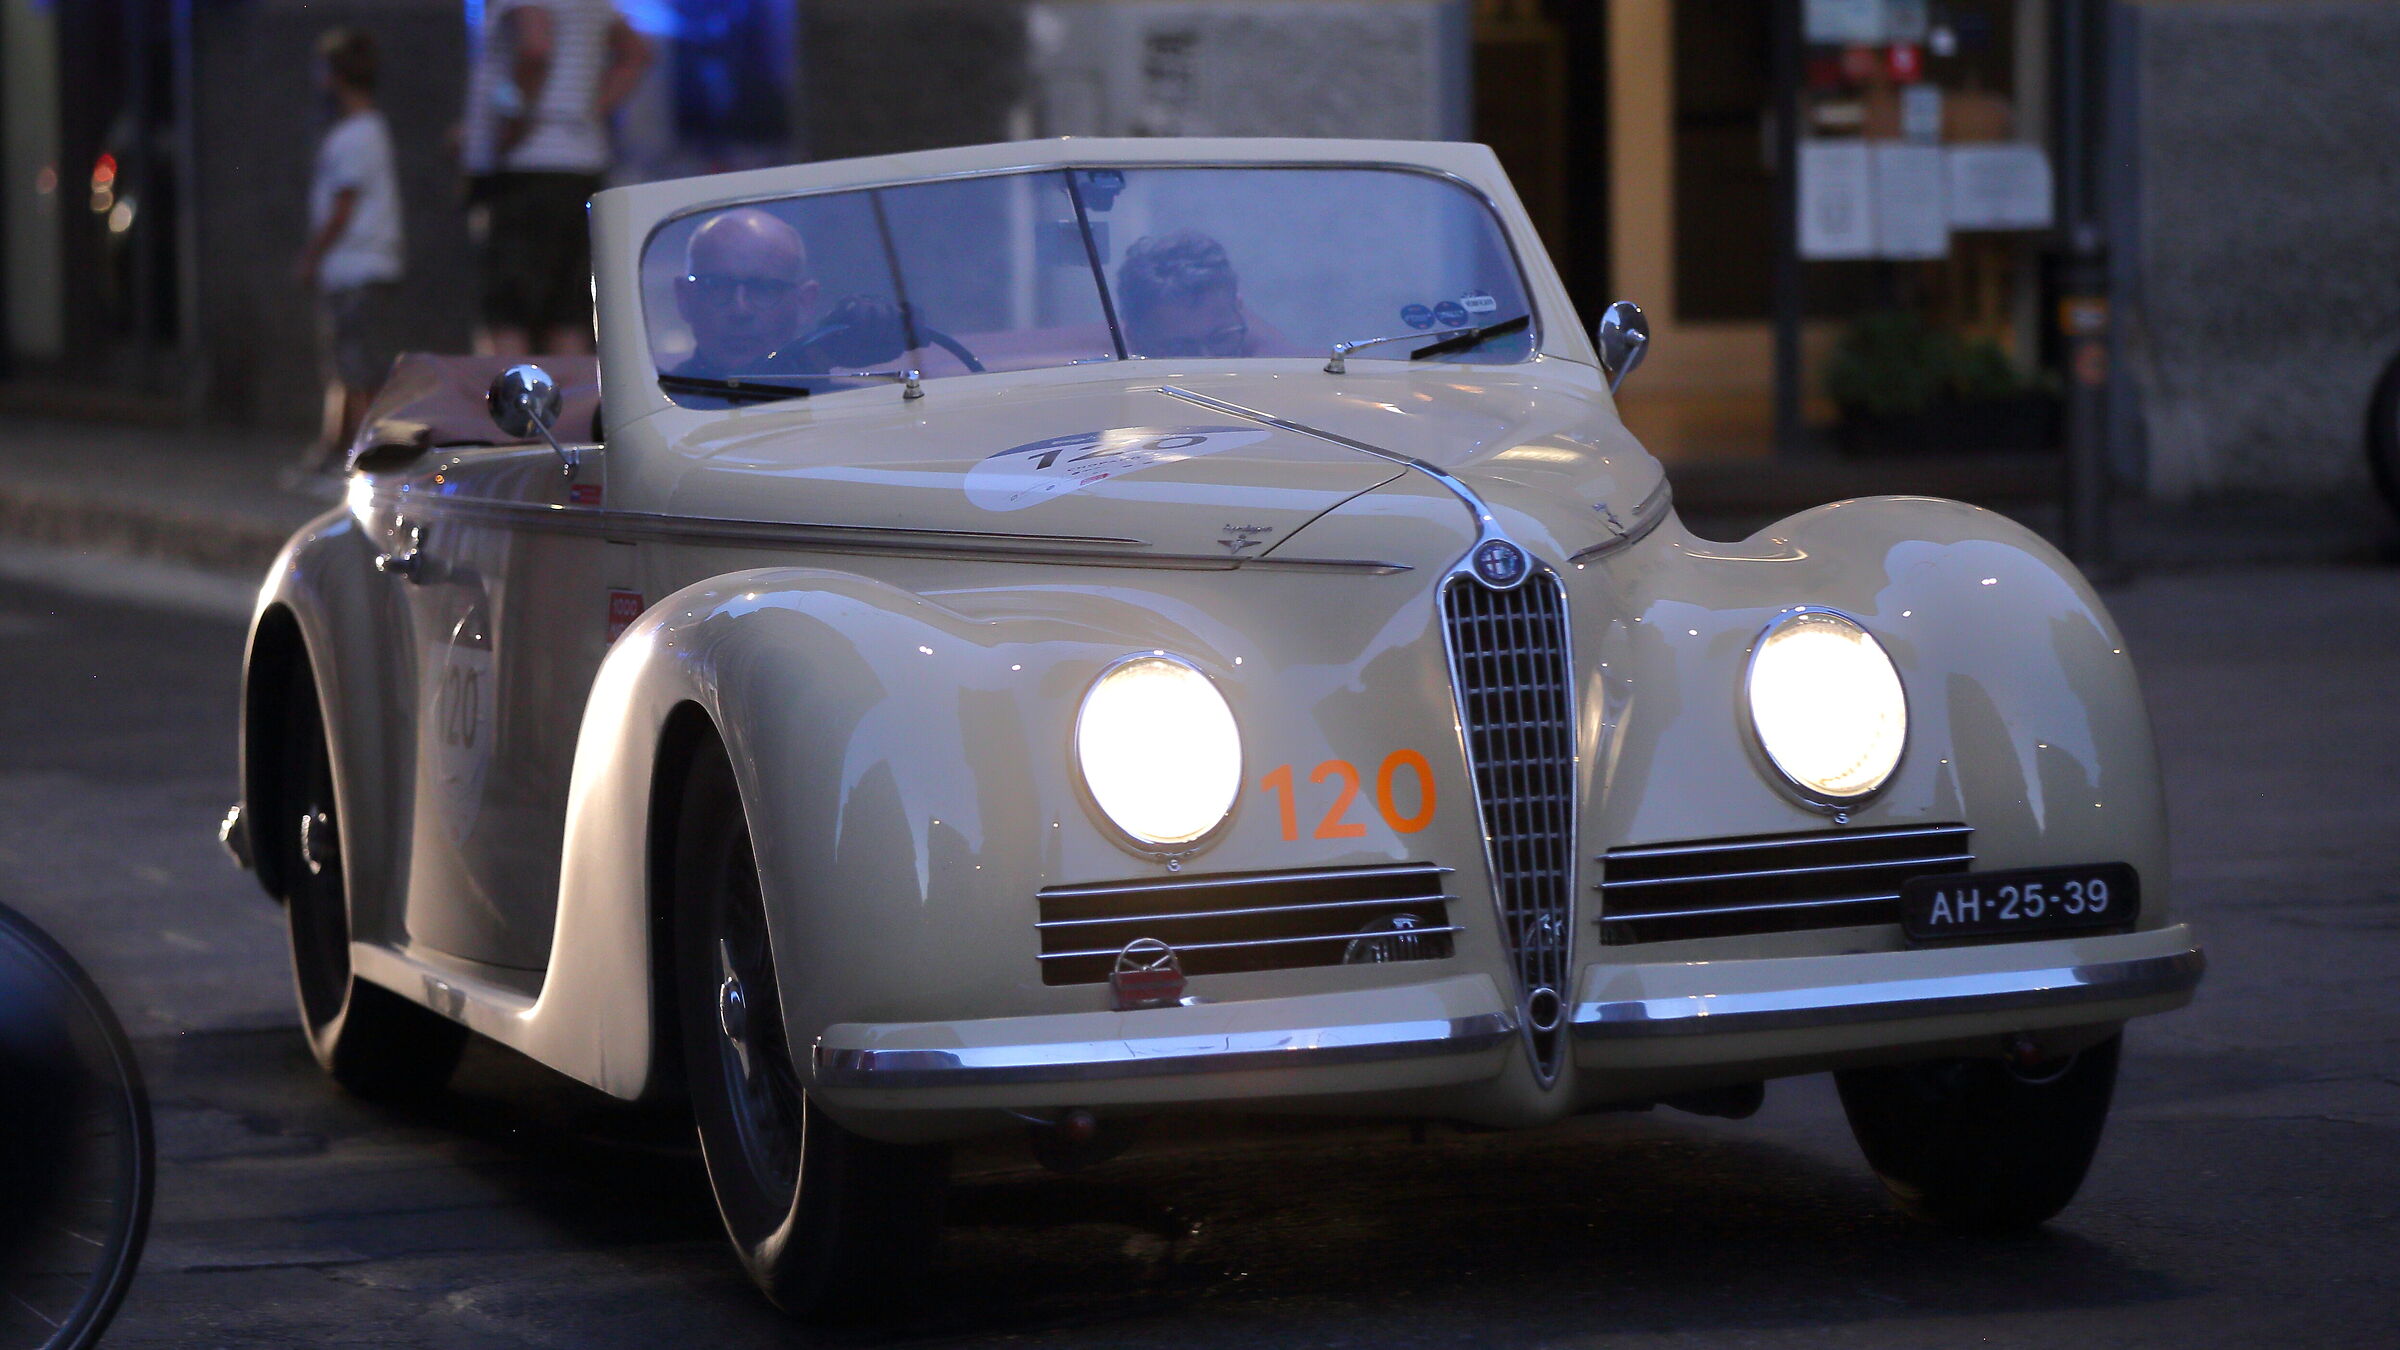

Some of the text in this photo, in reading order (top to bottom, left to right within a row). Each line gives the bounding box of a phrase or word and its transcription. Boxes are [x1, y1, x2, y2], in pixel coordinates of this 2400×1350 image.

[1027, 435, 1208, 470] 120
[1260, 748, 1437, 842] 120
[1929, 879, 2109, 925] AH-25-39
